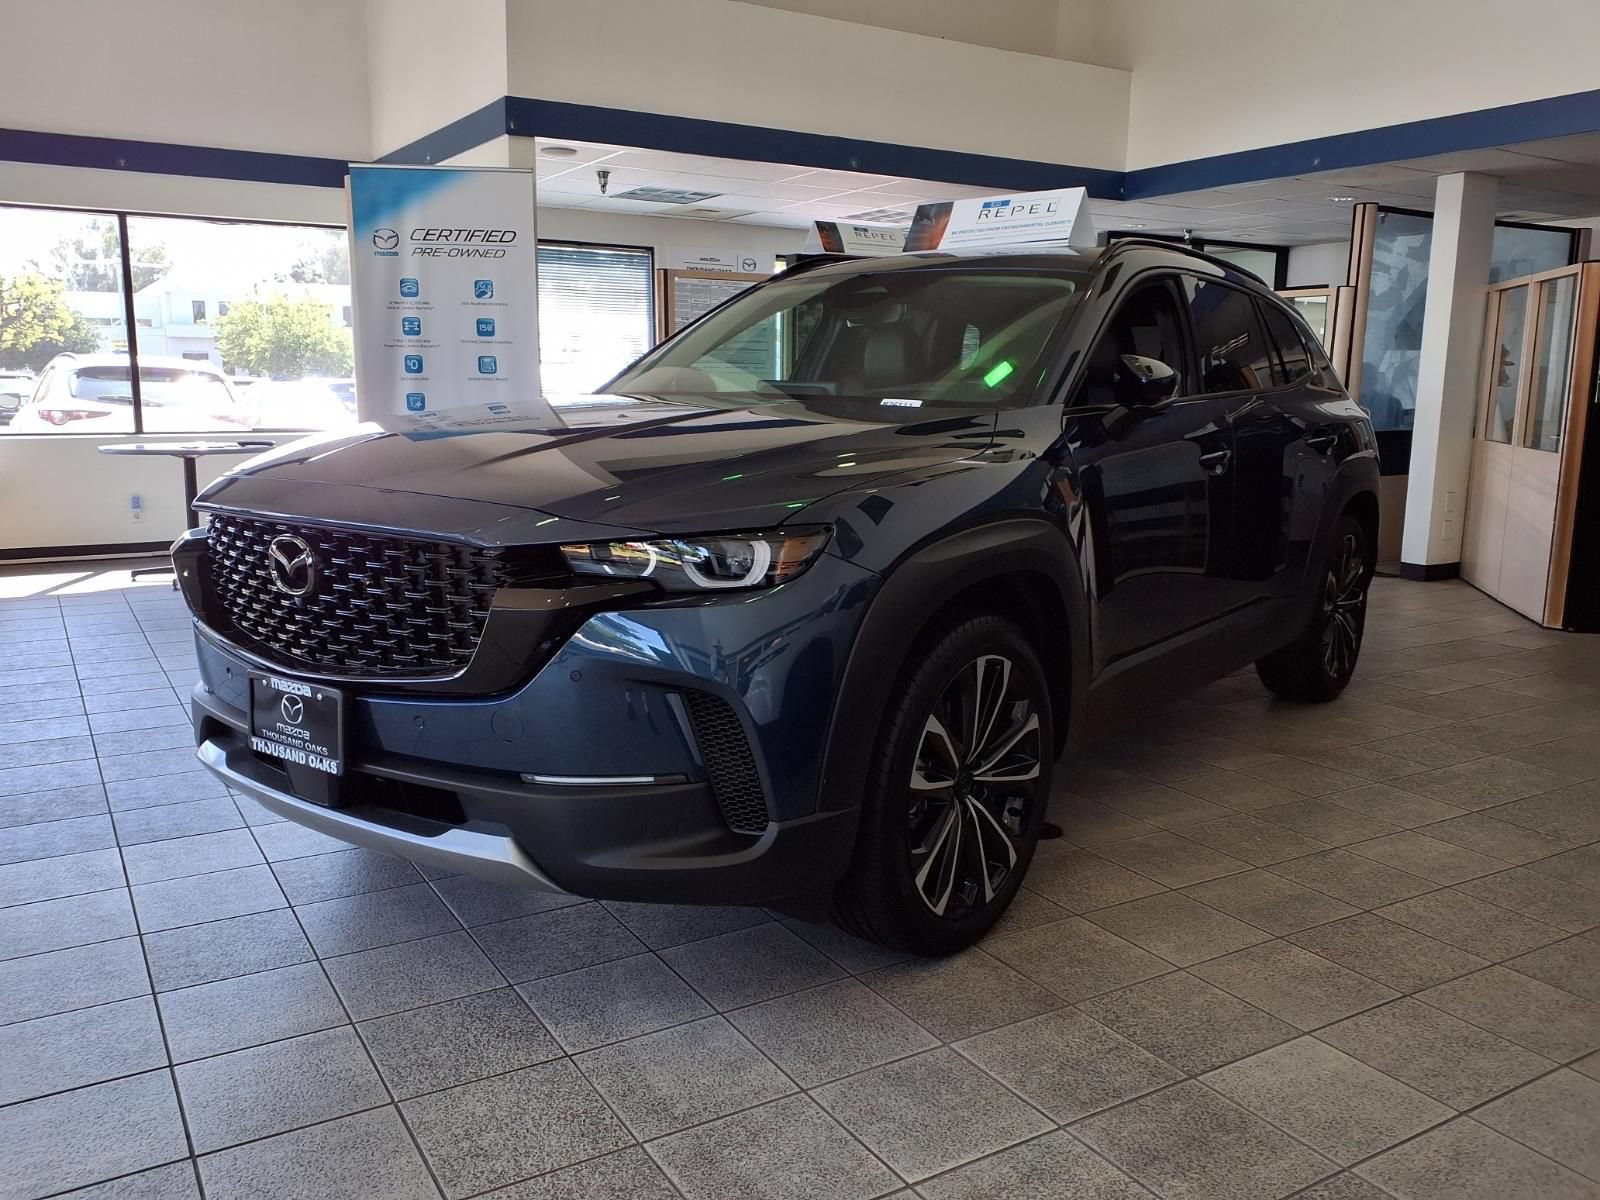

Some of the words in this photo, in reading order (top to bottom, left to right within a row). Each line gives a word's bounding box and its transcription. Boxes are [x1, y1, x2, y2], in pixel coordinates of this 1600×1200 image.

[977, 202, 1057, 220] REPEL
[409, 228, 517, 243] CERTIFIED
[854, 231, 896, 242] REPEL
[411, 247, 506, 259] PRE-OWNED
[261, 728, 304, 748] THOUSAND
[305, 743, 328, 756] OAKS
[251, 737, 306, 765] THOUSAND
[308, 755, 338, 775] OAKS
